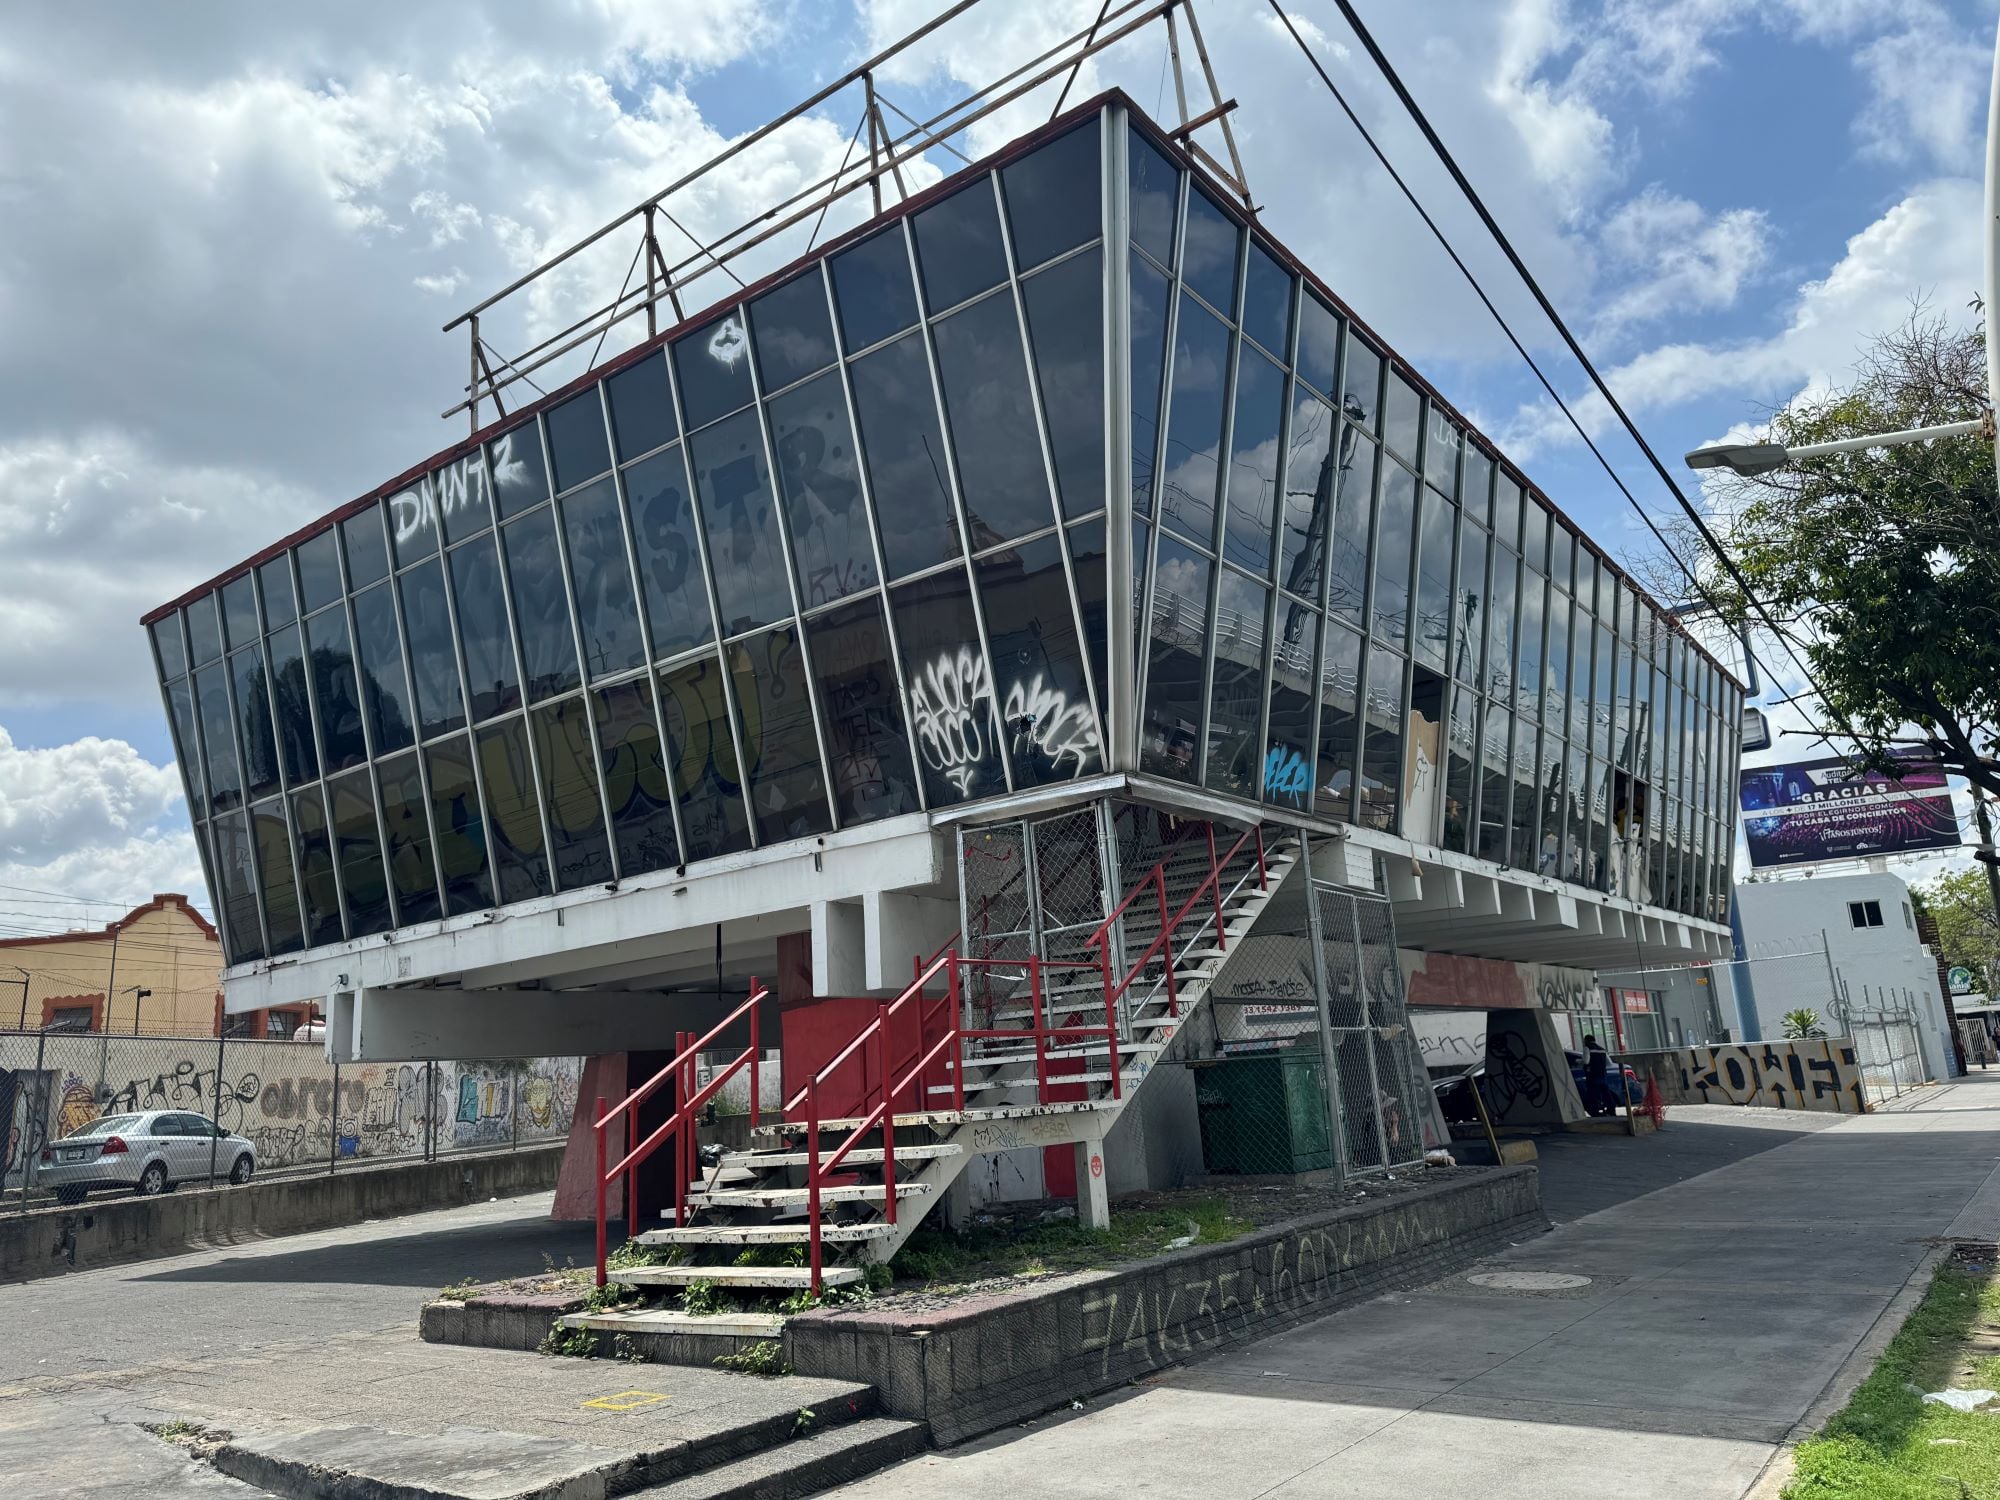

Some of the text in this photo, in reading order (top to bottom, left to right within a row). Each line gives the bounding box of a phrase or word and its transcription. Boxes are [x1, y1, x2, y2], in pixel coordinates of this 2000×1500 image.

[1801, 783, 1888, 803] GRACIAS
[1818, 797, 1866, 809] MILLONES
[1790, 807, 1907, 827] TU CASA DE CONCIERTOS
